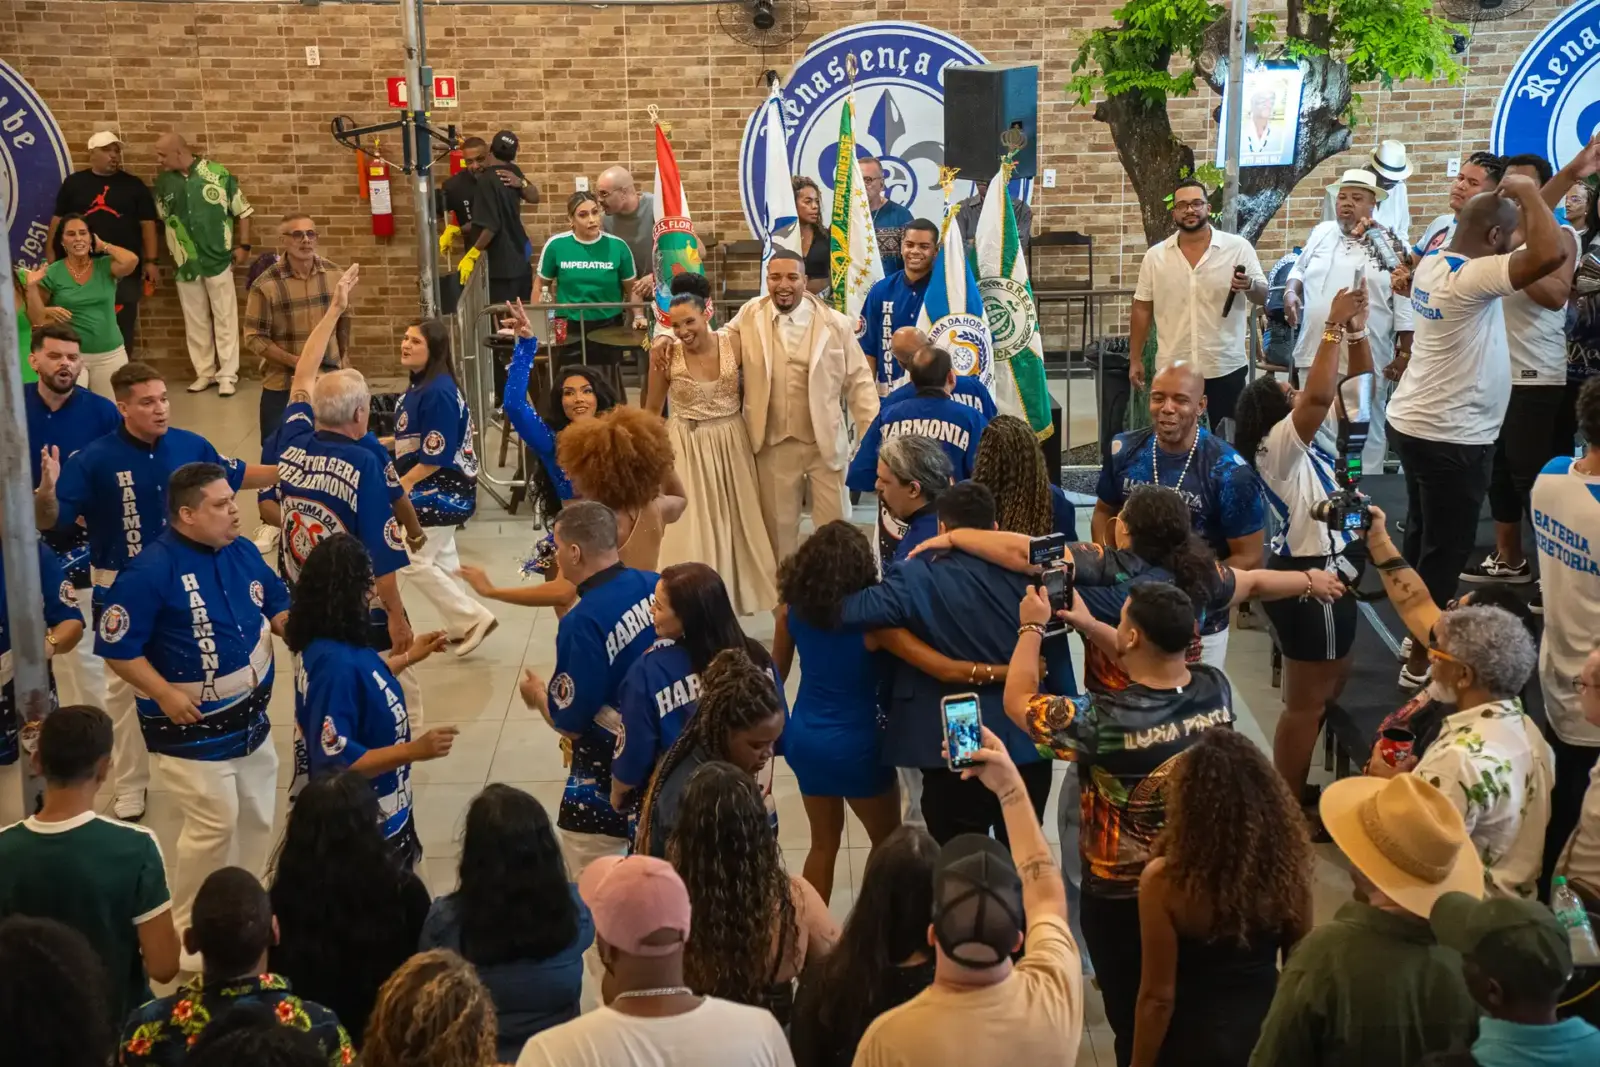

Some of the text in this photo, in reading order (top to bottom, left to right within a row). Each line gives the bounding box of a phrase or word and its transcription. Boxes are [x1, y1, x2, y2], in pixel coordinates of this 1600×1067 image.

[1518, 24, 1600, 107] Rena
[760, 46, 932, 144] enasença
[20, 220, 49, 259] 1951
[668, 220, 691, 231] FLOR
[560, 260, 614, 270] IMPERATRIZ
[947, 317, 961, 326] DA
[962, 317, 987, 335] HORA
[880, 418, 970, 452] HARMONIA
[116, 470, 142, 557] HARMON
[296, 502, 323, 519] CIMA
[323, 514, 338, 531] DA
[1534, 509, 1592, 556] BATERIA
[181, 573, 220, 702] HARMONIA
[294, 739, 309, 776] HORA
